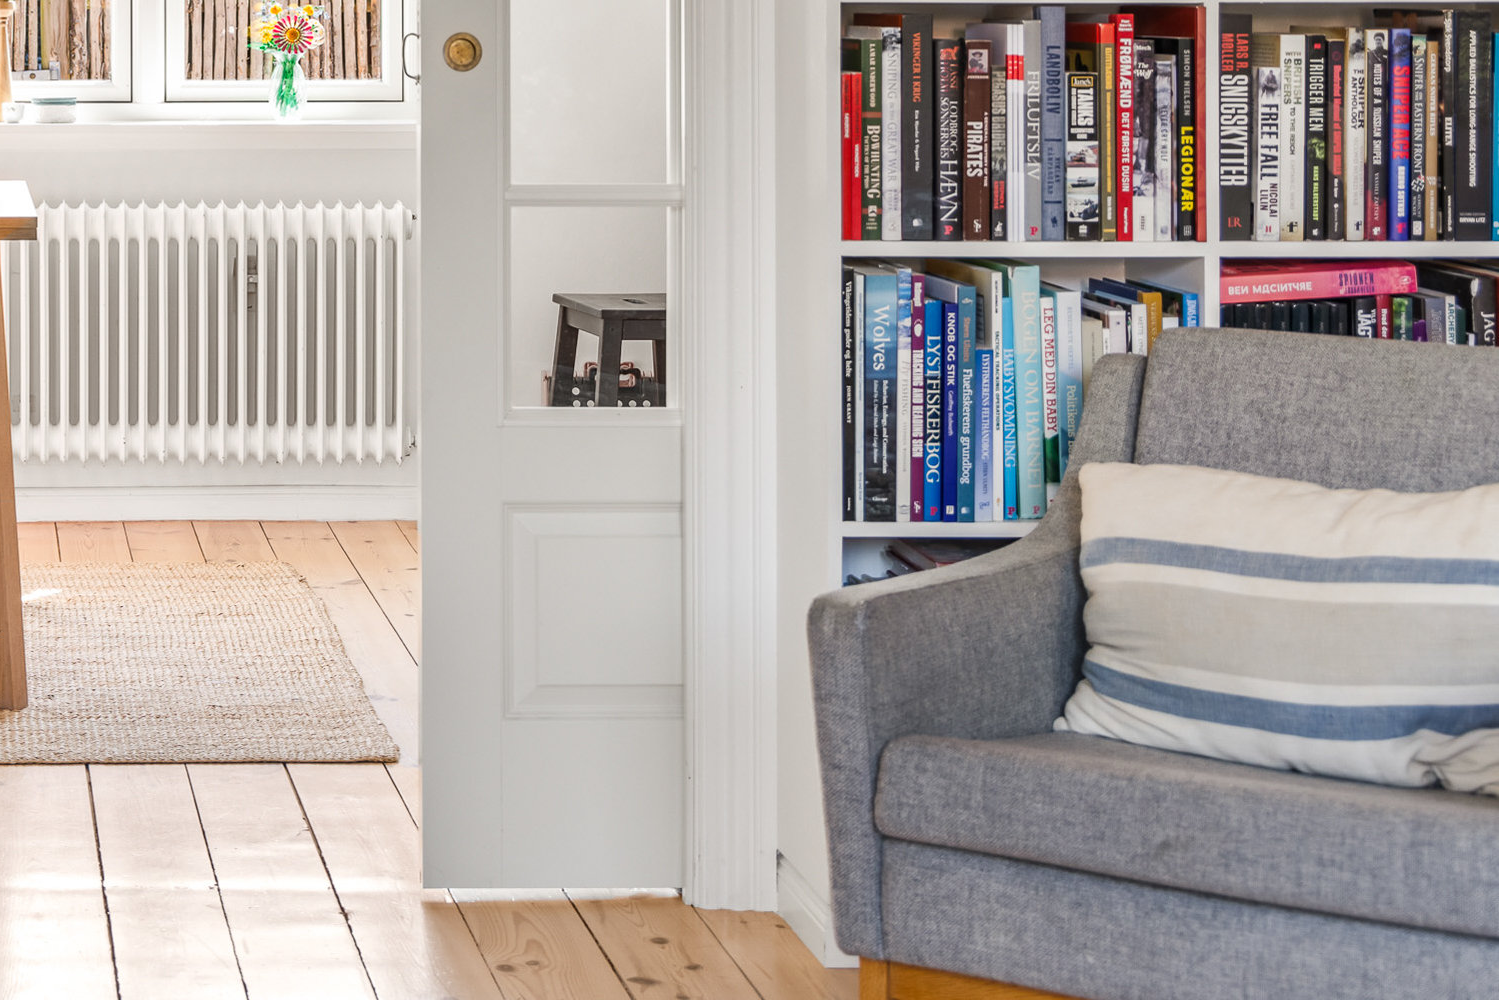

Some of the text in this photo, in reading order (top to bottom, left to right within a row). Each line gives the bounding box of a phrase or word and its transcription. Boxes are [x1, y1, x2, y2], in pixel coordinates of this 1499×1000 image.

[1046, 45, 1061, 114] LANDBOLIV
[1120, 38, 1131, 108] FRØMÆND
[1309, 58, 1324, 131] TRIGGER MEN
[1392, 65, 1410, 160] SNIPER ACE
[966, 121, 982, 177] PIRATES
[1027, 70, 1039, 180] FRILUFTSLIV
[1220, 74, 1248, 186] SNIGSKYTTER
[1260, 104, 1279, 181] FREE FALL
[1181, 126, 1193, 211] LEGIONÆR
[872, 305, 890, 371] Wolves
[947, 312, 955, 385] KNOB OG STIK
[1043, 307, 1058, 432] LEG MED DIN BABY
[926, 335, 940, 483] LYSTFISKERBOG
[960, 368, 973, 484] Fluefiskerens grundbog
